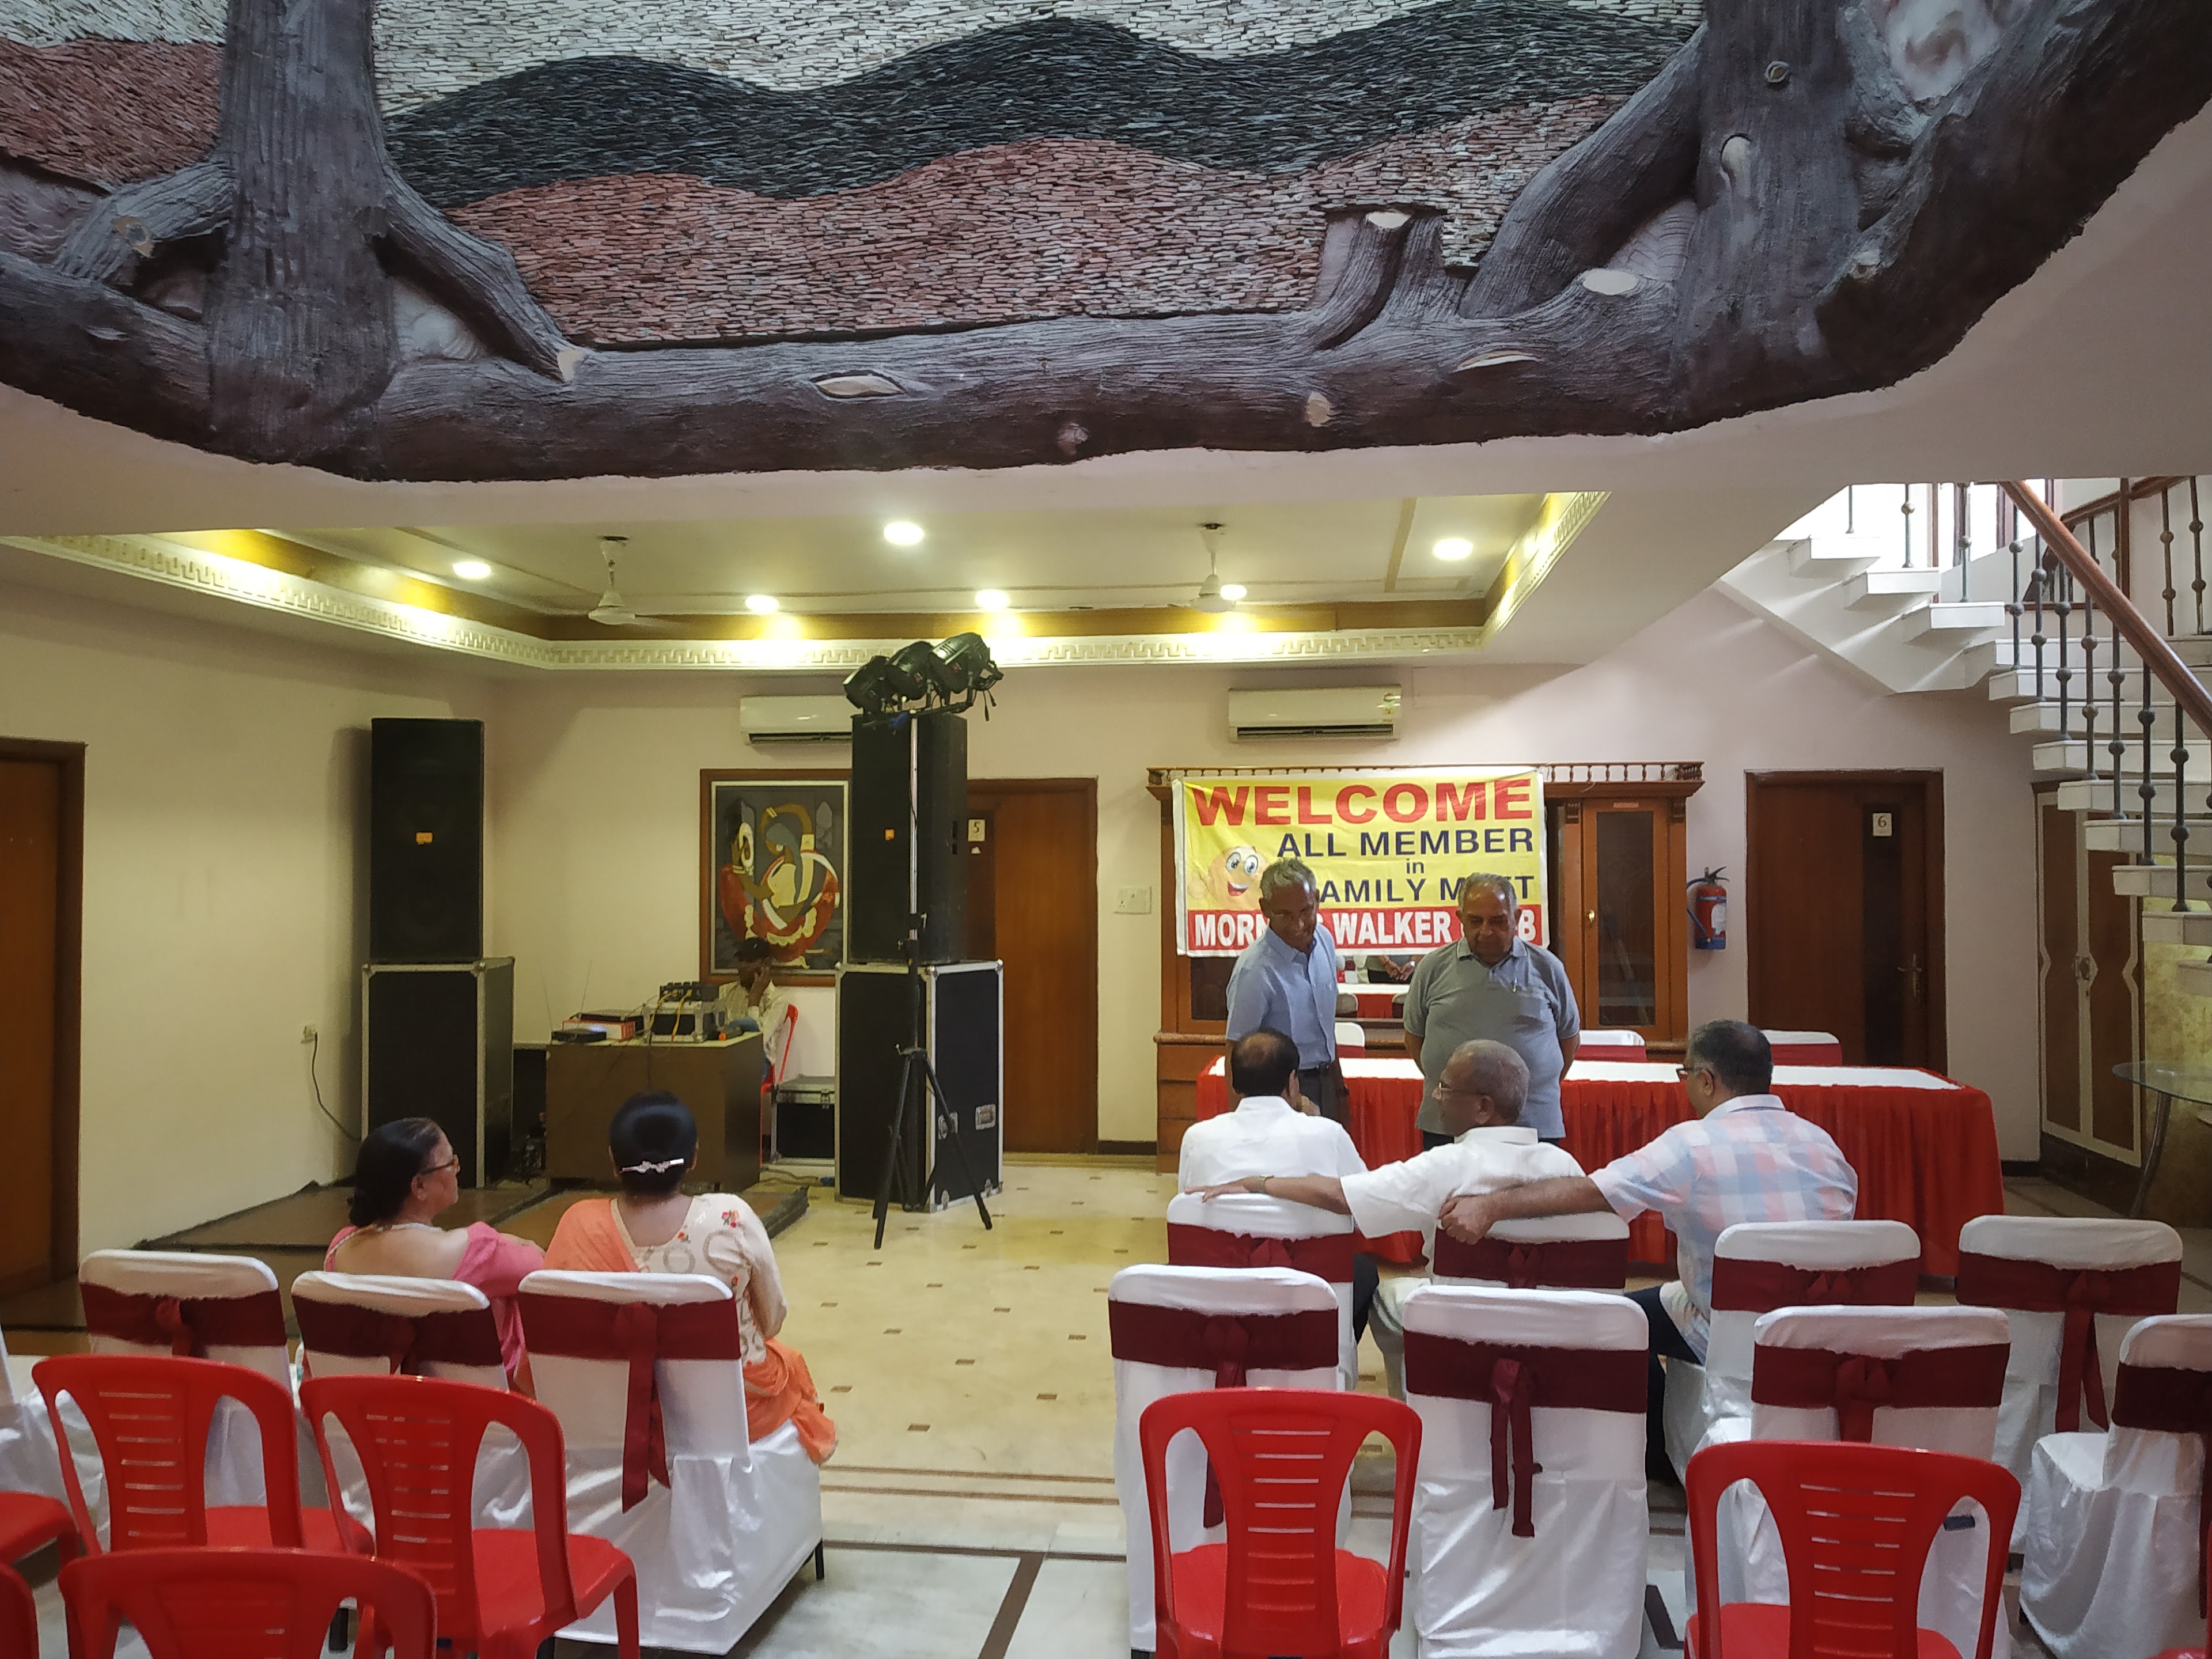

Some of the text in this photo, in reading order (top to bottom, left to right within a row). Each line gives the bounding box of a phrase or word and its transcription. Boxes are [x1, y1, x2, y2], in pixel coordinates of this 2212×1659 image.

[1192, 778, 1532, 825] WELCOME
[974, 821, 980, 834] 5
[1878, 815, 1888, 828] 6
[1277, 828, 1533, 857] ALL MEMBER
[1406, 858, 1425, 874] in
[1319, 876, 1535, 903] AMILY MT
[1332, 911, 1452, 945] WALKER
